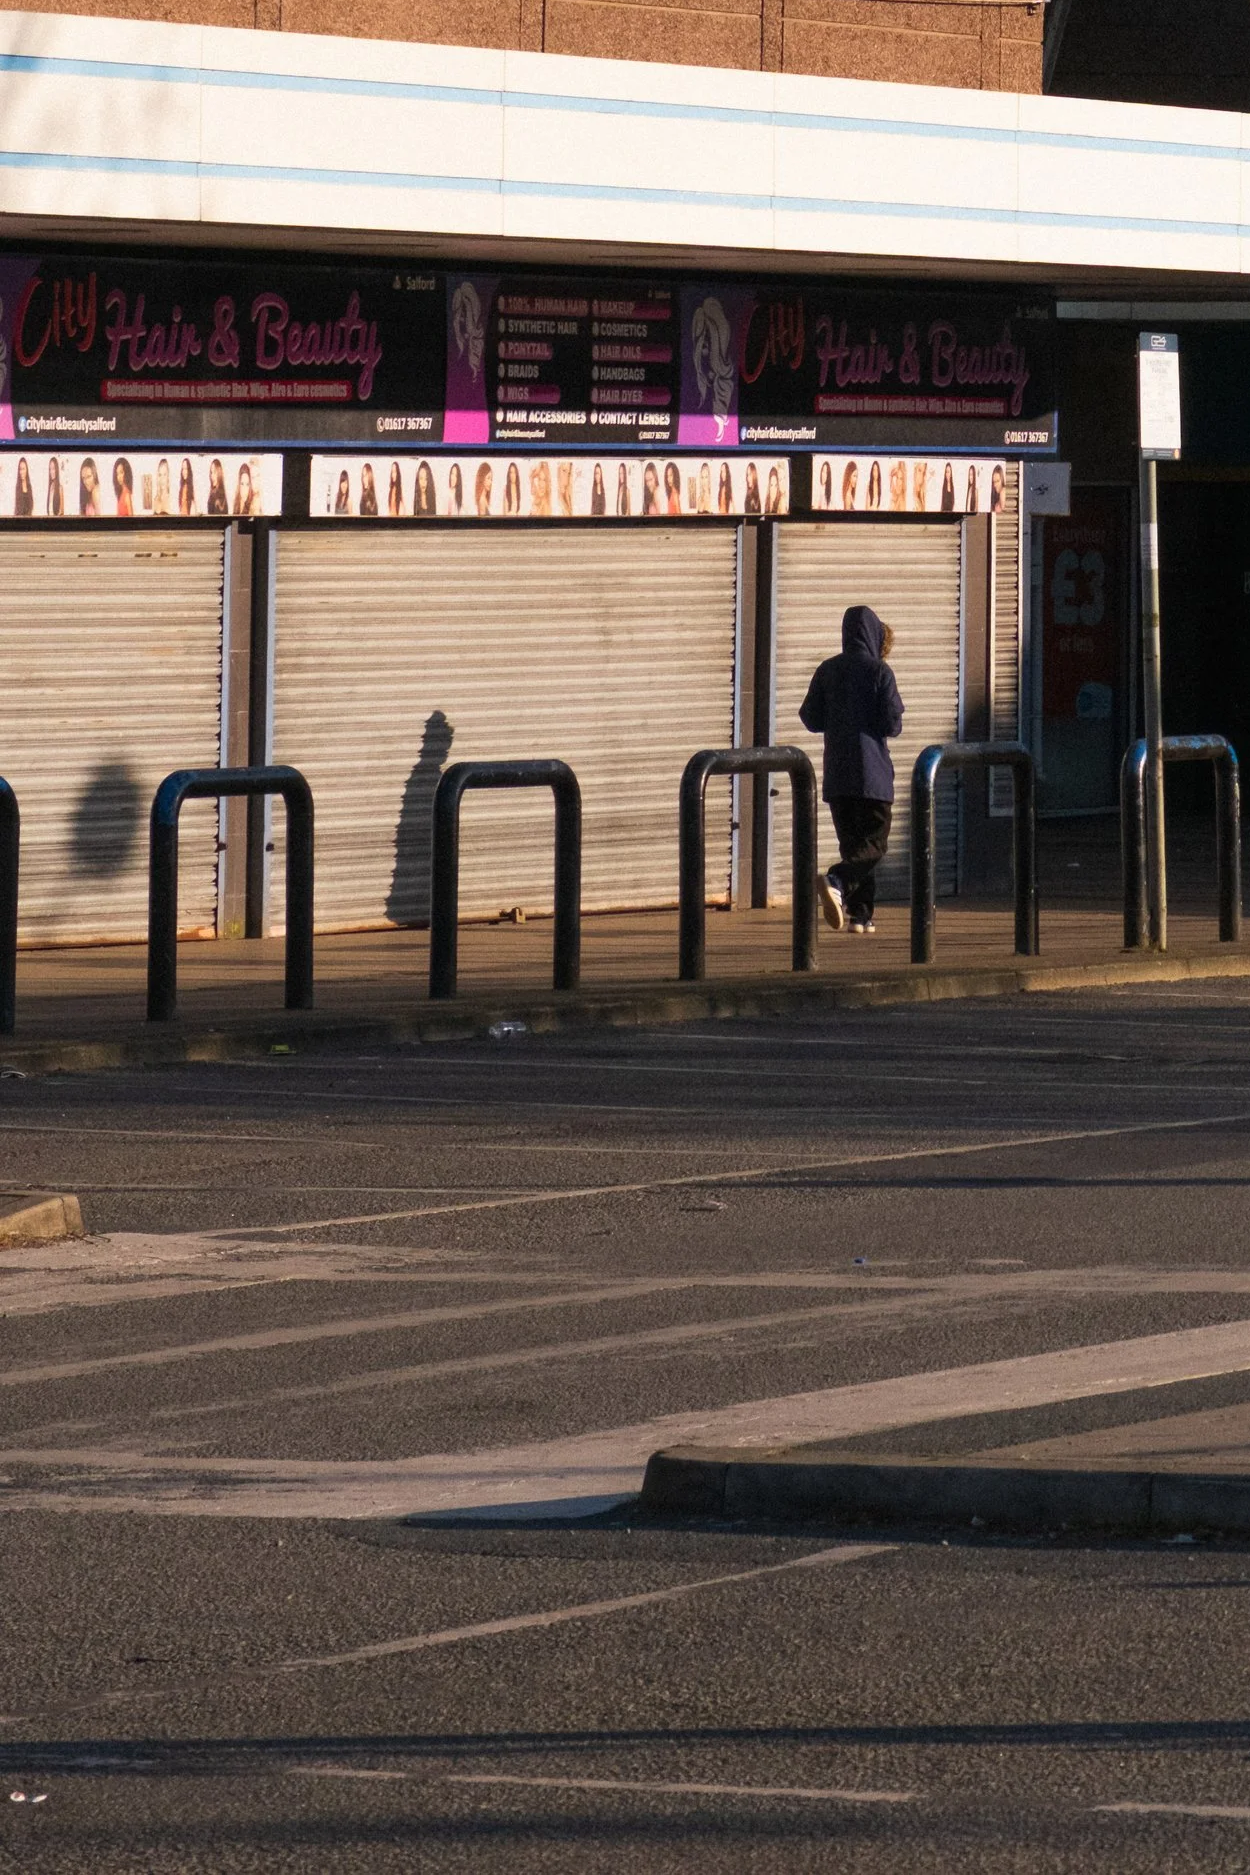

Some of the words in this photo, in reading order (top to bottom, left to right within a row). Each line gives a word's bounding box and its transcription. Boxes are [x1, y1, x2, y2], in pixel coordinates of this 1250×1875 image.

[406, 276, 436, 291] Salford
[535, 297, 566, 312] HUMAN
[566, 299, 588, 314] HAIR
[600, 301, 636, 316] MAKEUP
[508, 319, 556, 334] SYNTHETIC
[557, 321, 578, 334] HAIR
[600, 323, 648, 337] COSMETICS
[105, 288, 202, 372] Hair
[208, 293, 241, 370] &
[251, 289, 383, 400] Beauty
[508, 342, 549, 356] PONYTAIL
[600, 344, 620, 358] HAIR
[622, 346, 641, 359] OILS
[508, 365, 539, 378] BRAIDS
[815, 314, 894, 388] Hair
[899, 320, 921, 387] &
[928, 318, 1030, 417] Beauty
[600, 367, 645, 381] HANDBAGS
[155, 383, 163, 398] in
[507, 386, 529, 400] WIGS
[600, 388, 620, 402] HAIR
[622, 389, 643, 403] DYES
[26, 416, 116, 433] cityhair&beautysalford
[384, 417, 406, 430] 01617
[407, 417, 432, 430] 367367
[506, 410, 527, 423] HAIR
[528, 410, 587, 424] ACCESSORIES
[599, 411, 636, 425] CONTACT
[638, 413, 671, 425] LENSES
[746, 426, 817, 442] cityhair&beautysalford
[1010, 431, 1028, 443] 01617
